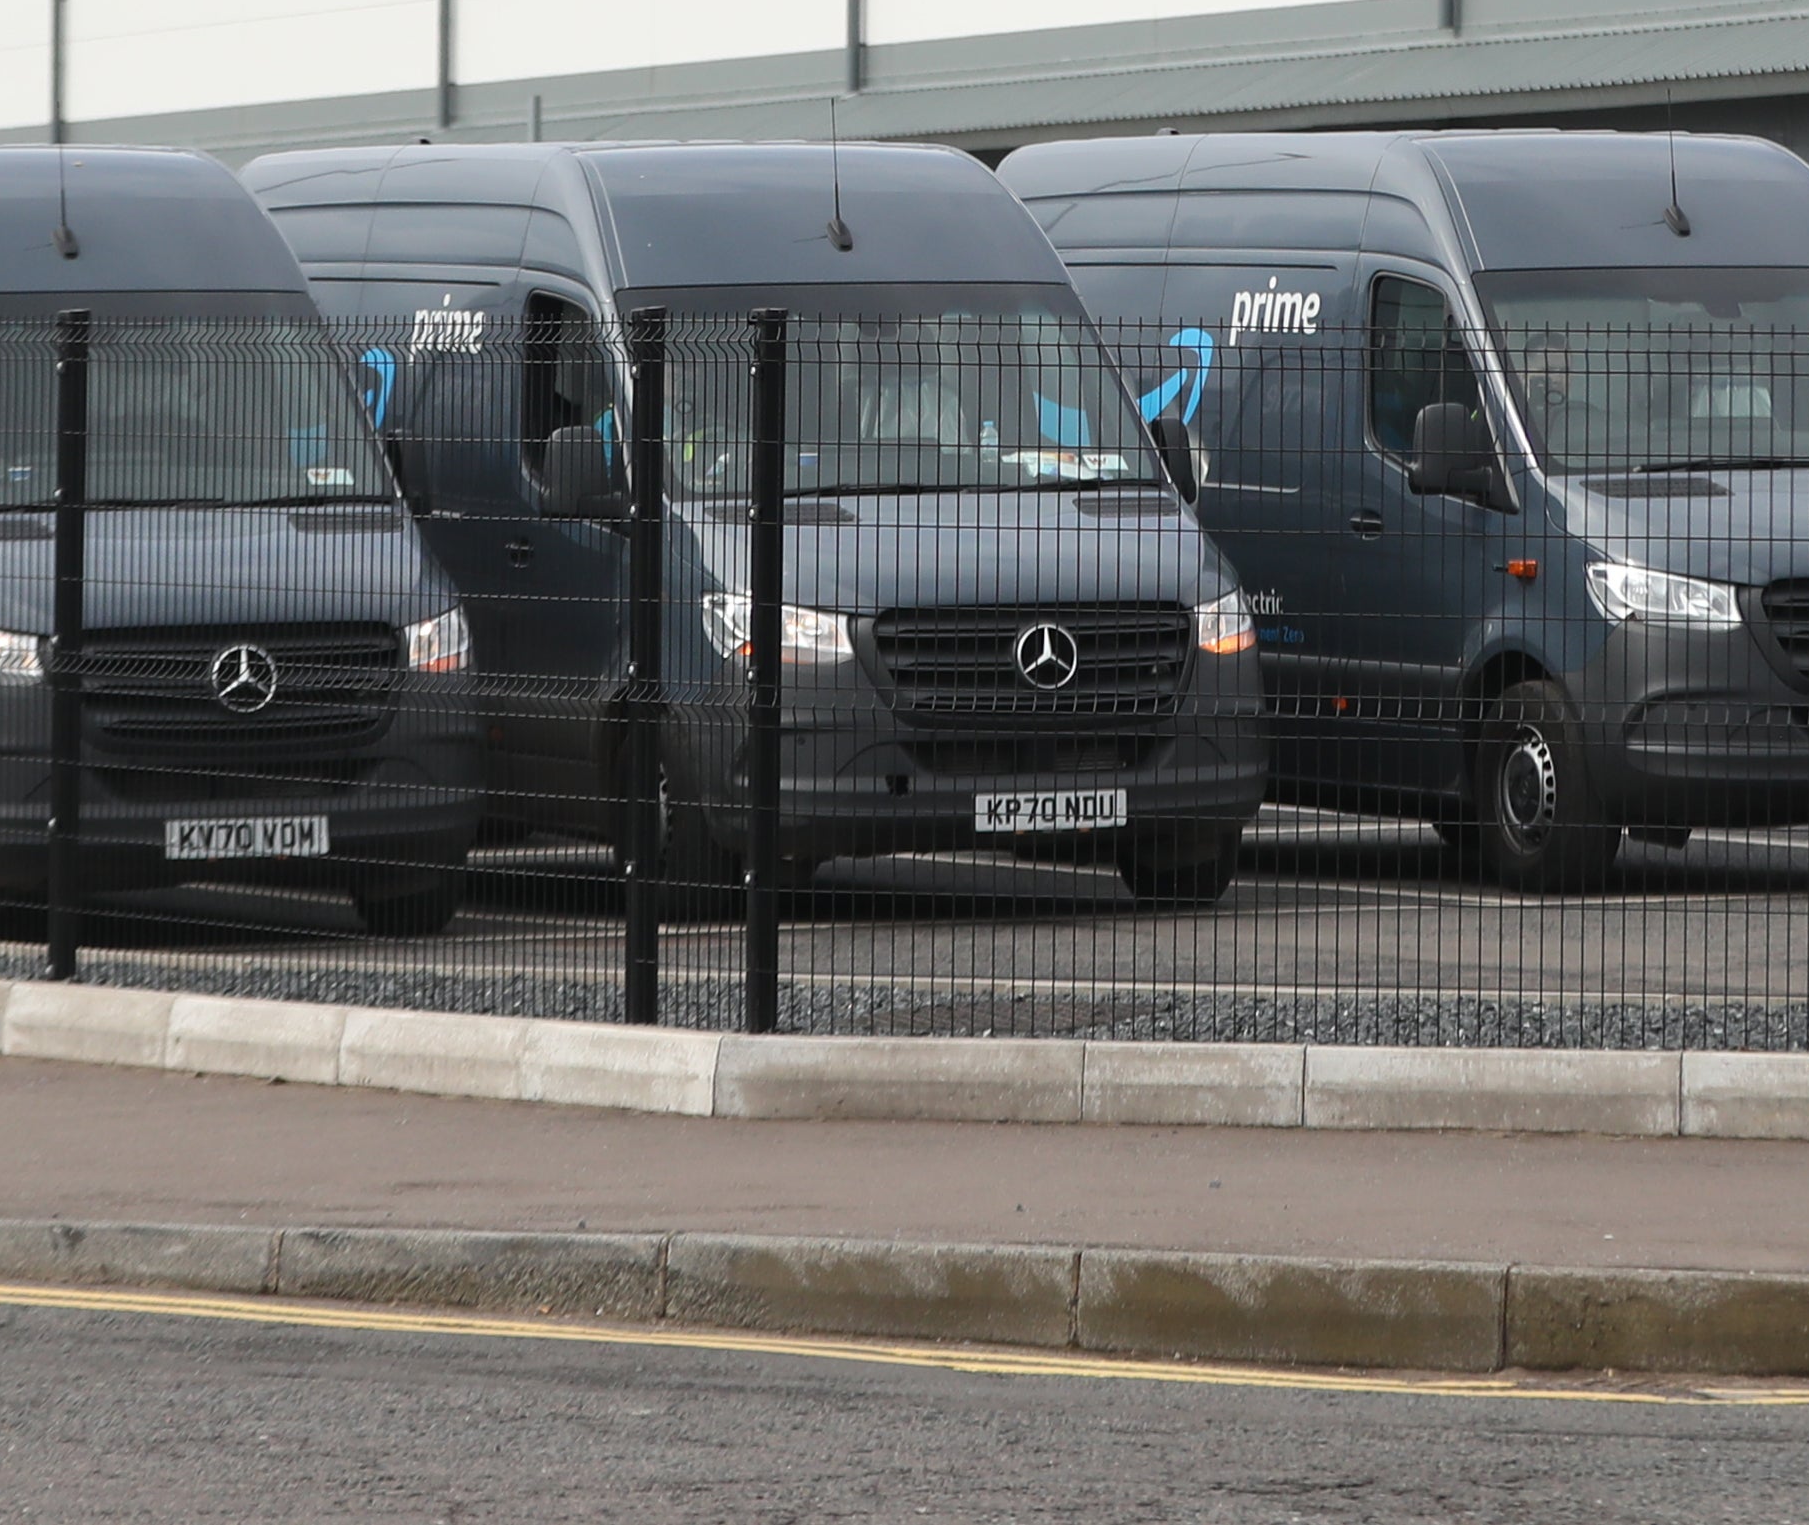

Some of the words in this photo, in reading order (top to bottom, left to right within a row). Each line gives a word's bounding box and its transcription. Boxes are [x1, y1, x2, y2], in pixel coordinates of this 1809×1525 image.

[409, 293, 486, 366] prime
[1229, 275, 1321, 347] prime
[987, 796, 1056, 826] KP70
[1064, 794, 1114, 823] NDU
